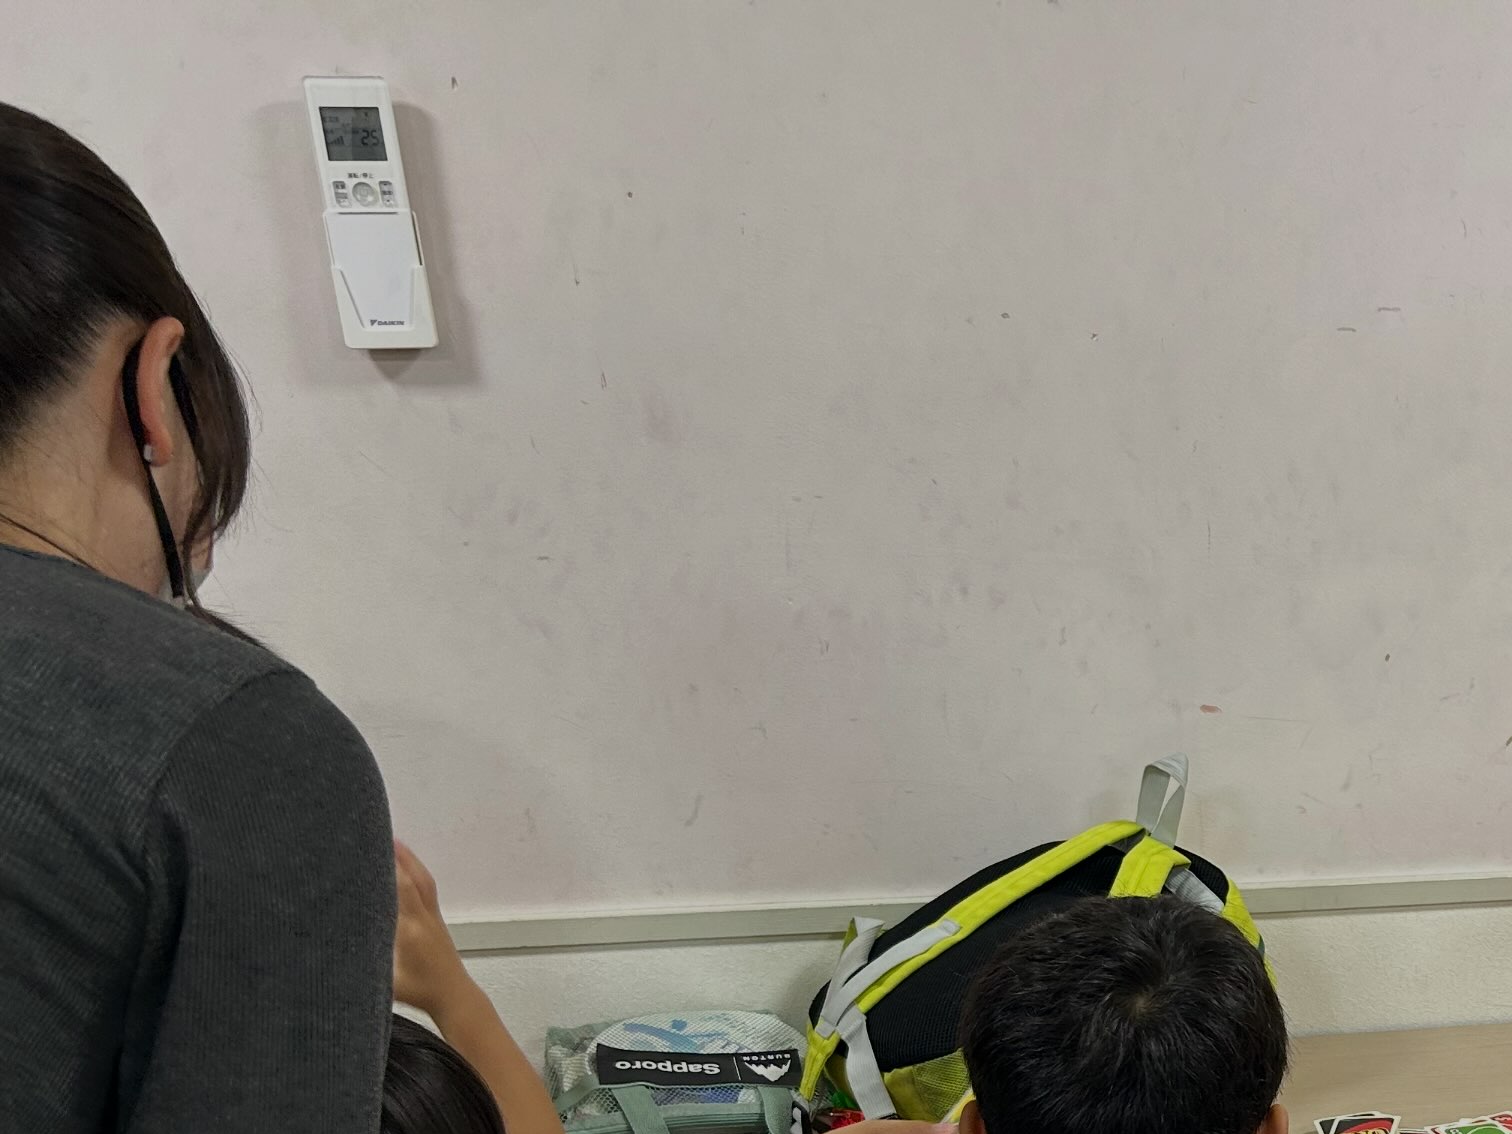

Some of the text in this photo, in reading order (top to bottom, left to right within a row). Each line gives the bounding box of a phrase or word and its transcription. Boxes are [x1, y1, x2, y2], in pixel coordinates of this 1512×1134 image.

[360, 129, 379, 146] 25
[742, 1053, 791, 1062] BURTON
[614, 1060, 721, 1075] Sapporo
